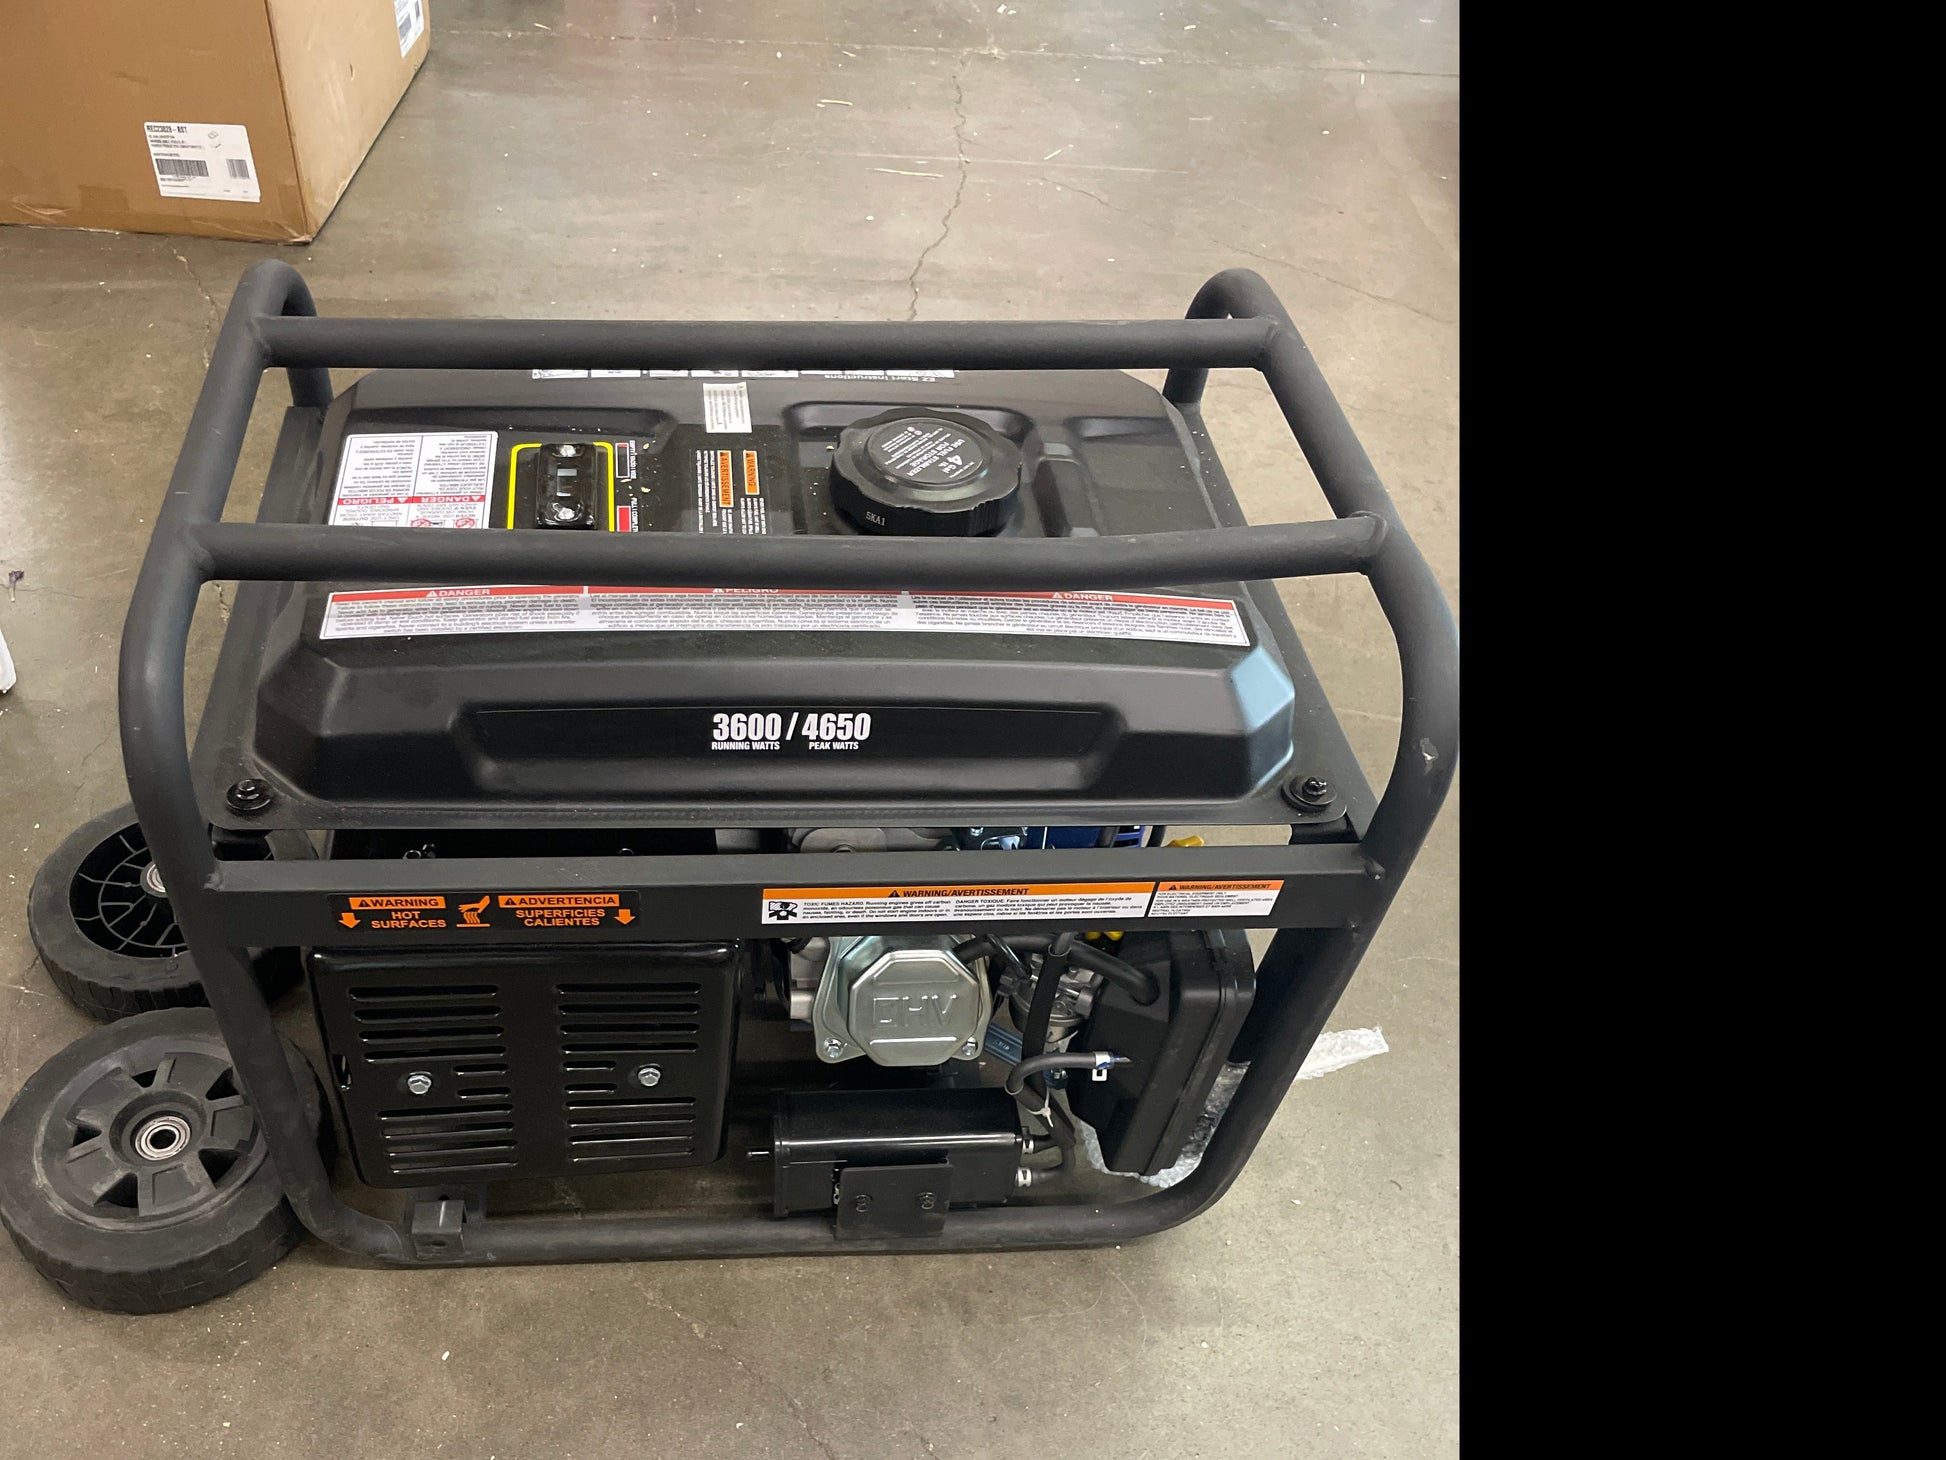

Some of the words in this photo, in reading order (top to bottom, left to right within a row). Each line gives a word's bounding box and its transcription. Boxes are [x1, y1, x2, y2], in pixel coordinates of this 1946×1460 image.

[745, 458, 757, 487] WARNING
[720, 457, 731, 506] AVERTISSEMENT
[439, 589, 490, 597] DANGER
[1064, 592, 1113, 601] DANGER
[713, 713, 782, 741] 3600
[785, 712, 799, 741] /
[801, 713, 872, 741] 4650
[712, 741, 750, 750] RUNNING
[751, 741, 780, 750] WATTS
[809, 741, 831, 750] PEAK
[832, 741, 859, 750] WATTS
[903, 888, 1029, 897] WARNING/AVERTISSEMENT
[371, 898, 439, 908] WARNING
[518, 896, 616, 906] ADVERTENCIA
[391, 911, 421, 920] HOT
[515, 908, 606, 918] SUPERFICIES
[370, 920, 447, 929] SURFACES
[524, 917, 600, 927] CALIENTES
